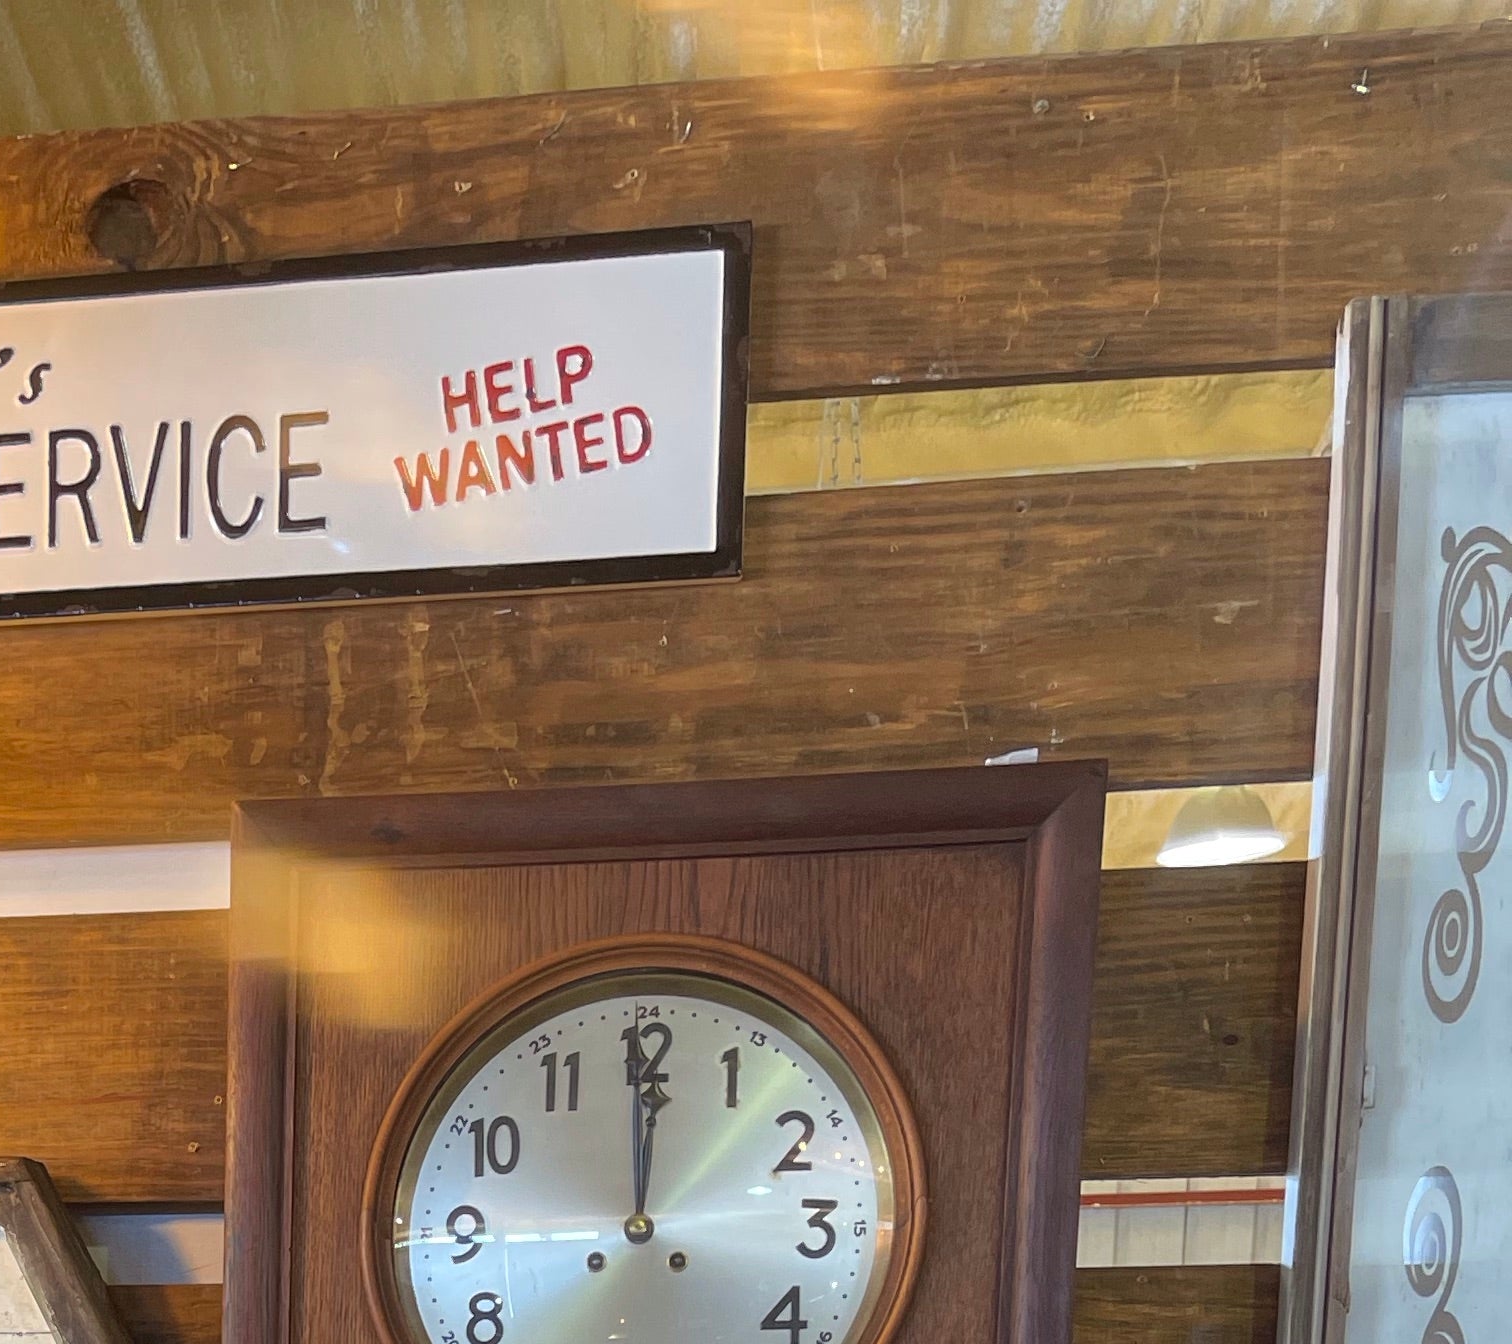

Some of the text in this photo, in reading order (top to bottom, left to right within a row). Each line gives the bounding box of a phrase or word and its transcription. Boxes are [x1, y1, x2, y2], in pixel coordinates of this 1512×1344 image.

[441, 344, 593, 434] HELP
[393, 405, 653, 512] WANTED
[529, 1032, 552, 1054] 23
[636, 1006, 661, 1020] 24
[748, 1030, 768, 1049] 13
[539, 1050, 582, 1113] 11
[620, 1022, 674, 1086] 12
[720, 1046, 741, 1109] 1
[449, 1114, 470, 1136] 22
[468, 1115, 521, 1178] 10
[773, 1109, 816, 1173] 2
[825, 1108, 845, 1129] 14
[445, 1204, 487, 1265] 9
[795, 1198, 839, 1260] 3
[852, 1218, 867, 1239] 15
